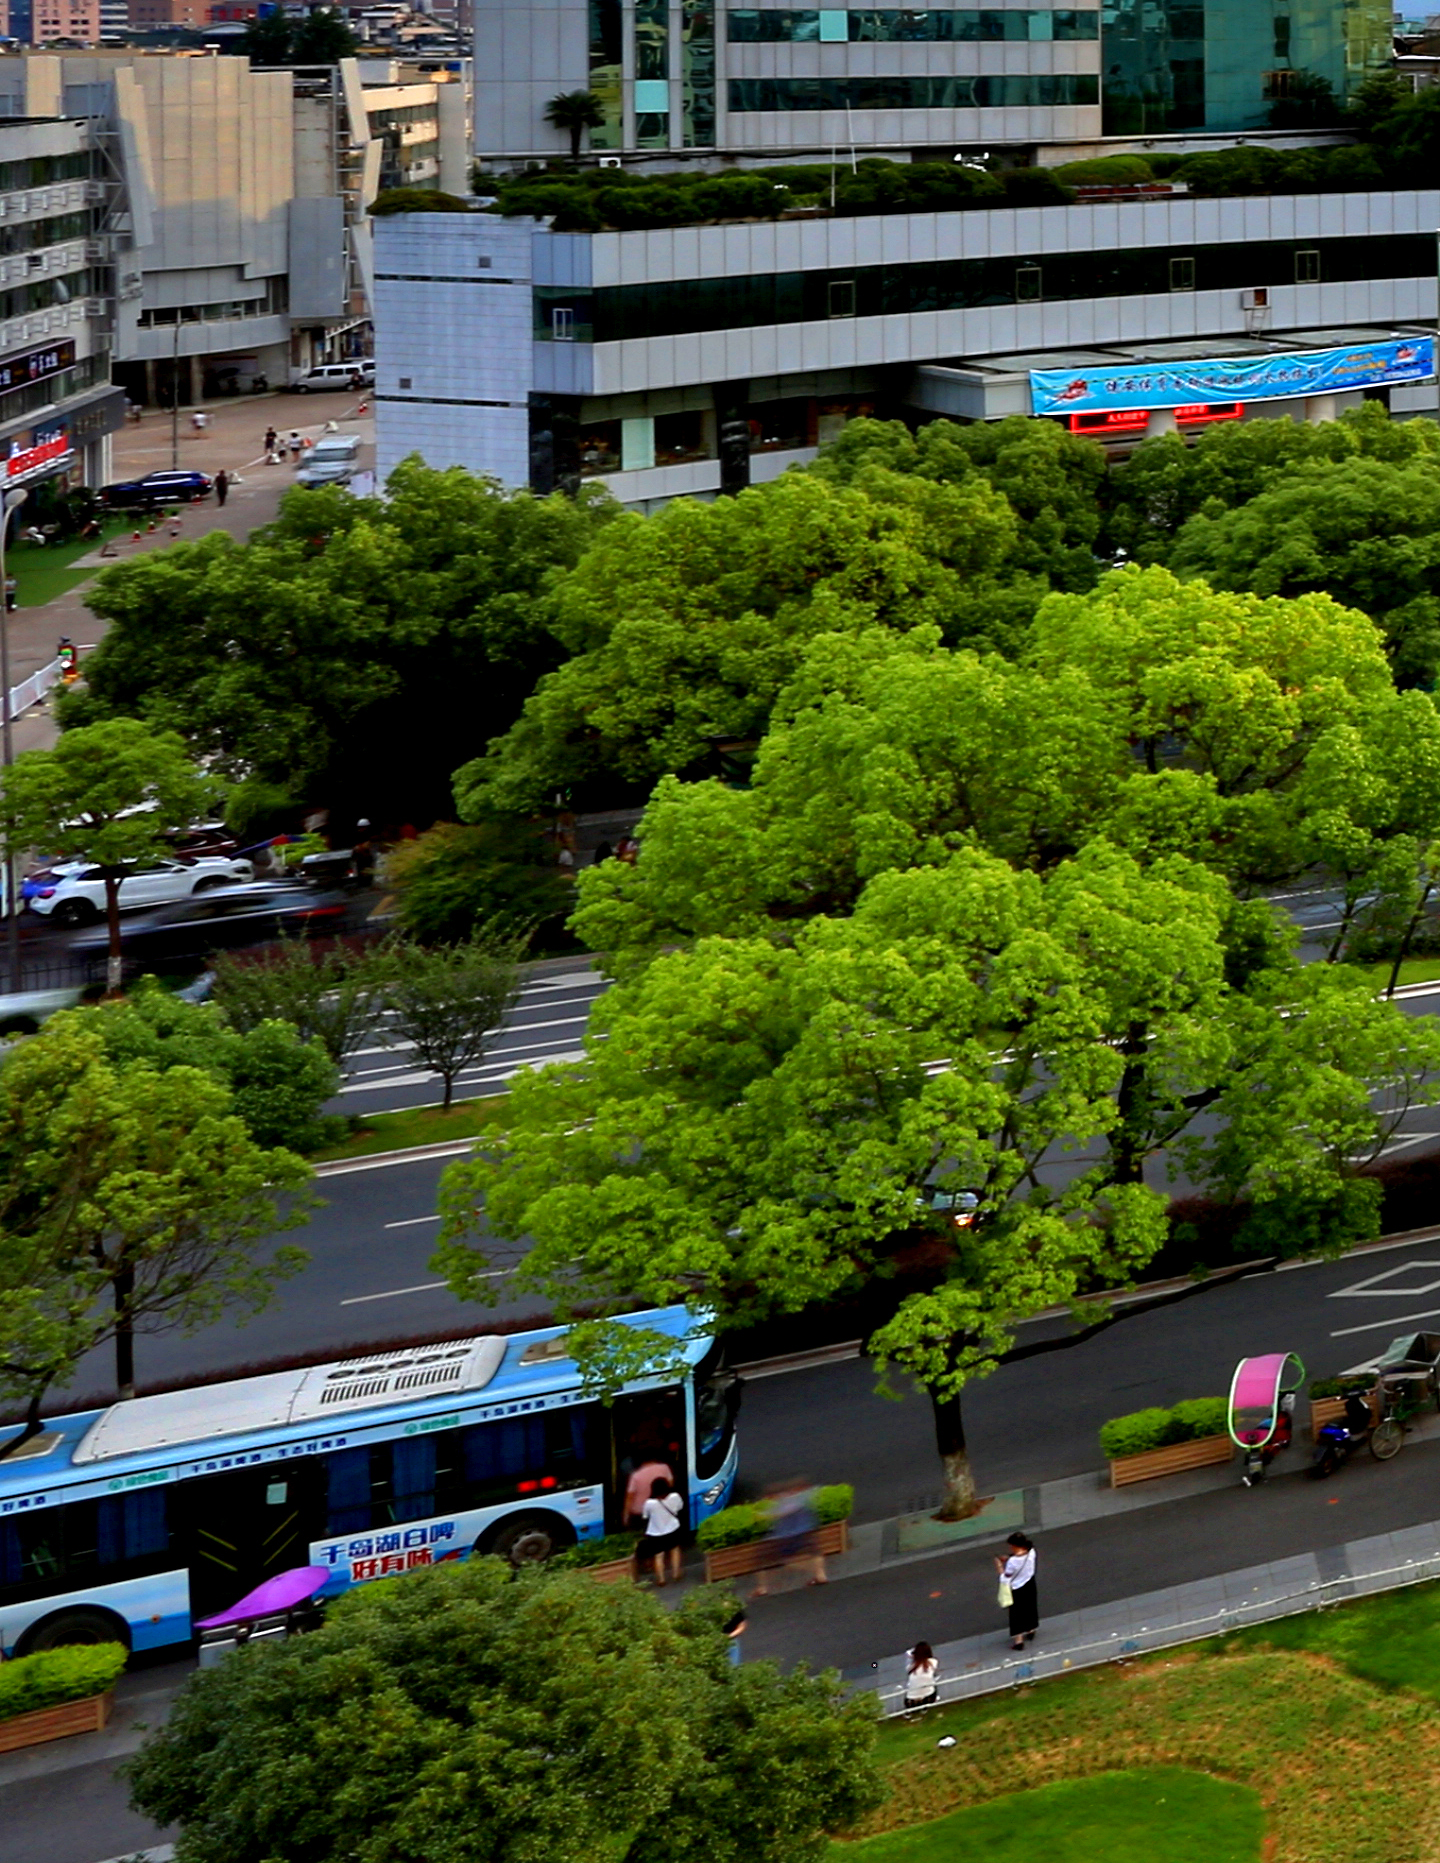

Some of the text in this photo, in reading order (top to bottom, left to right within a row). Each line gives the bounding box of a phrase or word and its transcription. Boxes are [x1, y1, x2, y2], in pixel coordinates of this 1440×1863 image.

[320, 1520, 455, 1565] 千岛湖白啤
[352, 1547, 433, 1581] 好有味
